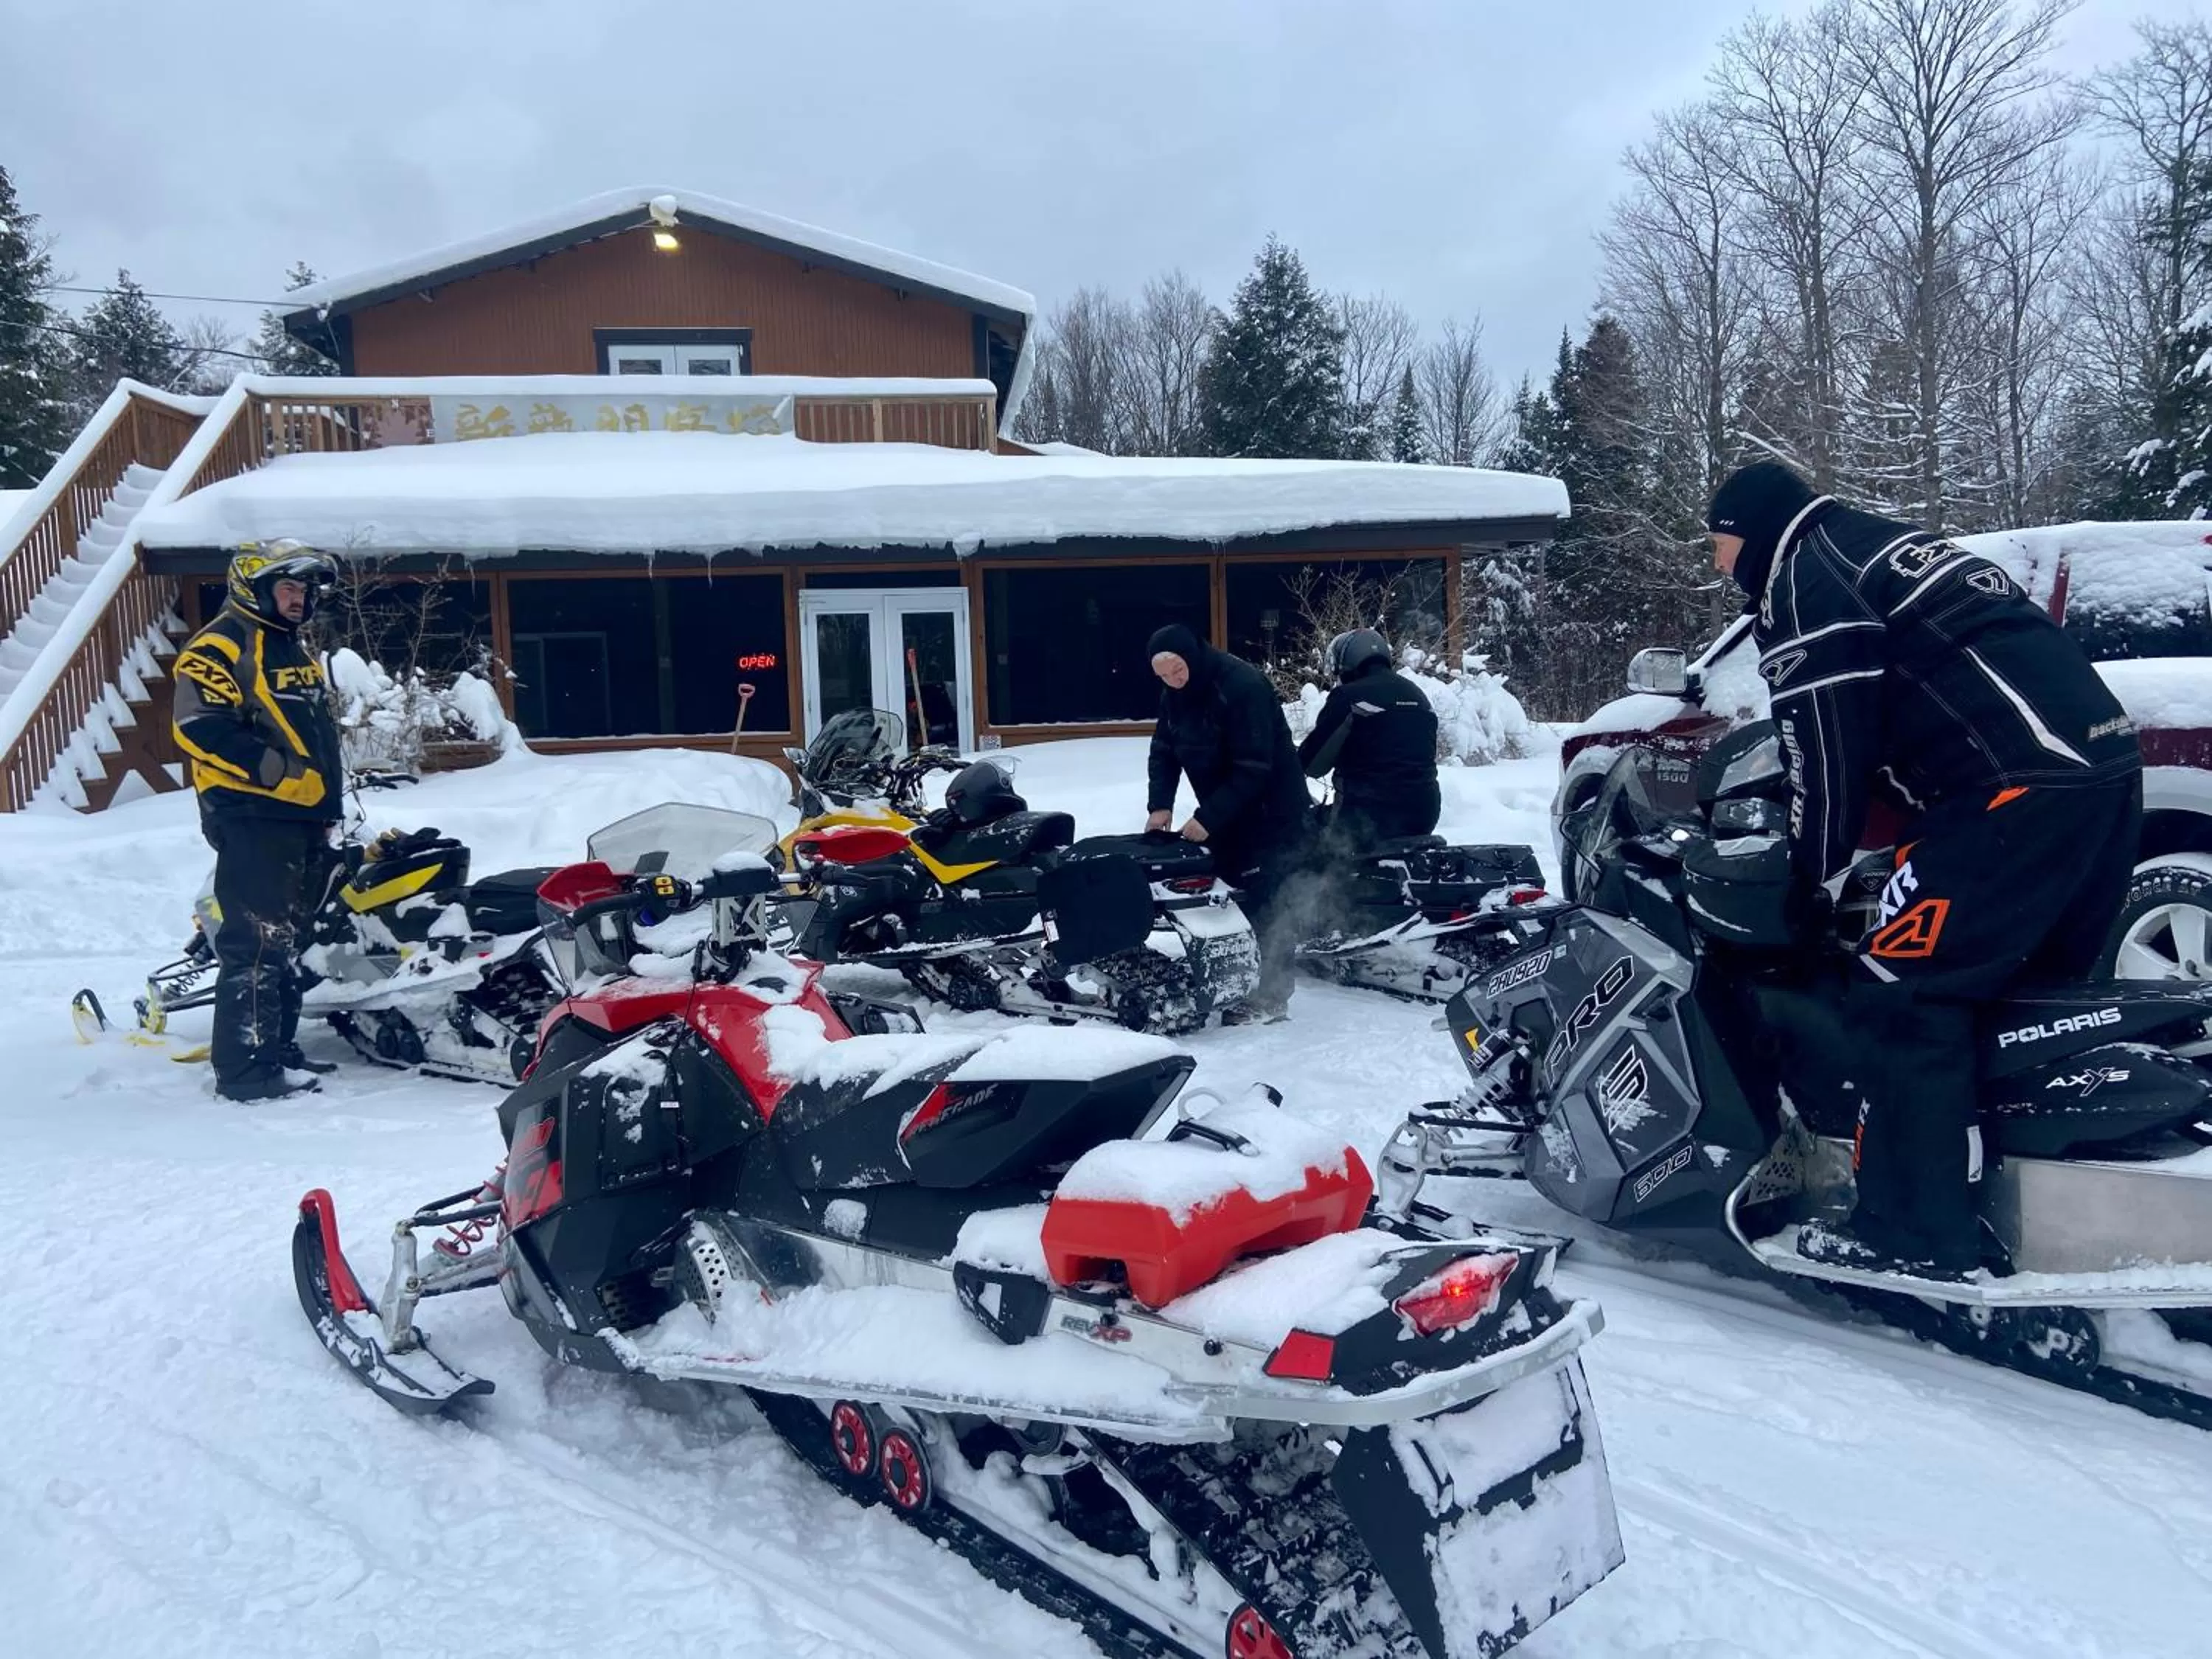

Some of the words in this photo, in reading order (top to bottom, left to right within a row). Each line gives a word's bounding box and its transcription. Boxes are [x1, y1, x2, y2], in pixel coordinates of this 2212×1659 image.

[271, 665, 323, 689] FXR
[739, 655, 774, 668] OPEN
[1658, 772, 1689, 783] 1500
[1878, 860, 1919, 928] XR
[1544, 956, 1635, 1090] PRO
[1997, 1007, 2122, 1048] POLARIS
[2045, 1067, 2130, 1096] AXYS
[1634, 1146, 1692, 1203] 600
